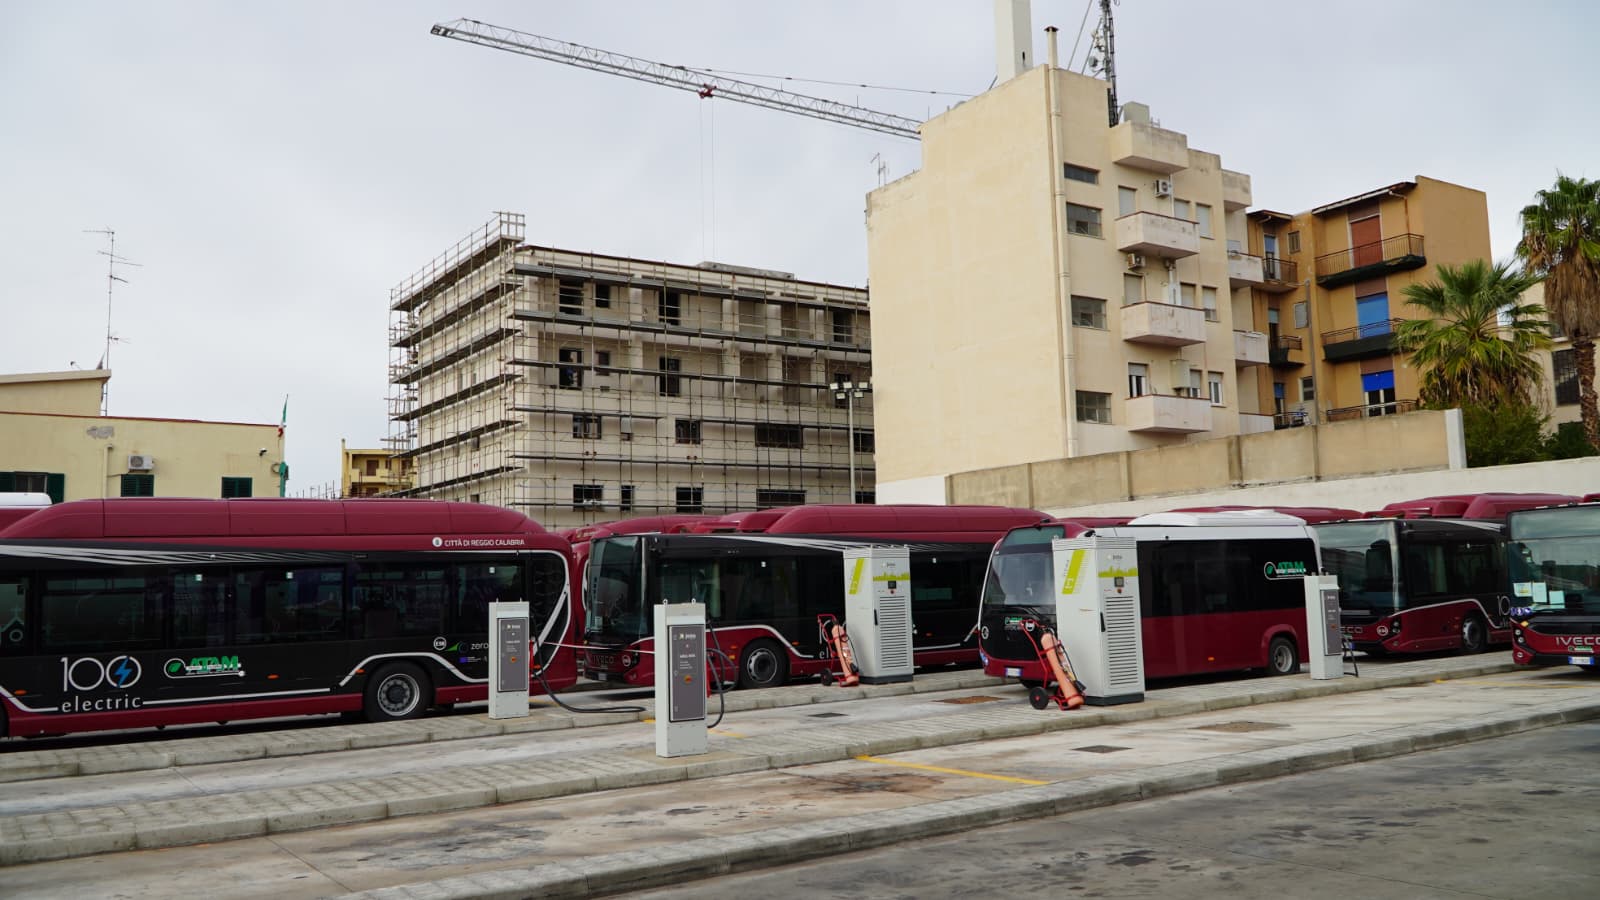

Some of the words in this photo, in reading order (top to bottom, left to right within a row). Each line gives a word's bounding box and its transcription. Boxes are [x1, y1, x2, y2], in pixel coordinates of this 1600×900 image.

[495, 538, 525, 546] CALABRIA
[188, 655, 239, 672] ATAM
[61, 655, 142, 692] 100
[62, 694, 141, 713] electric
